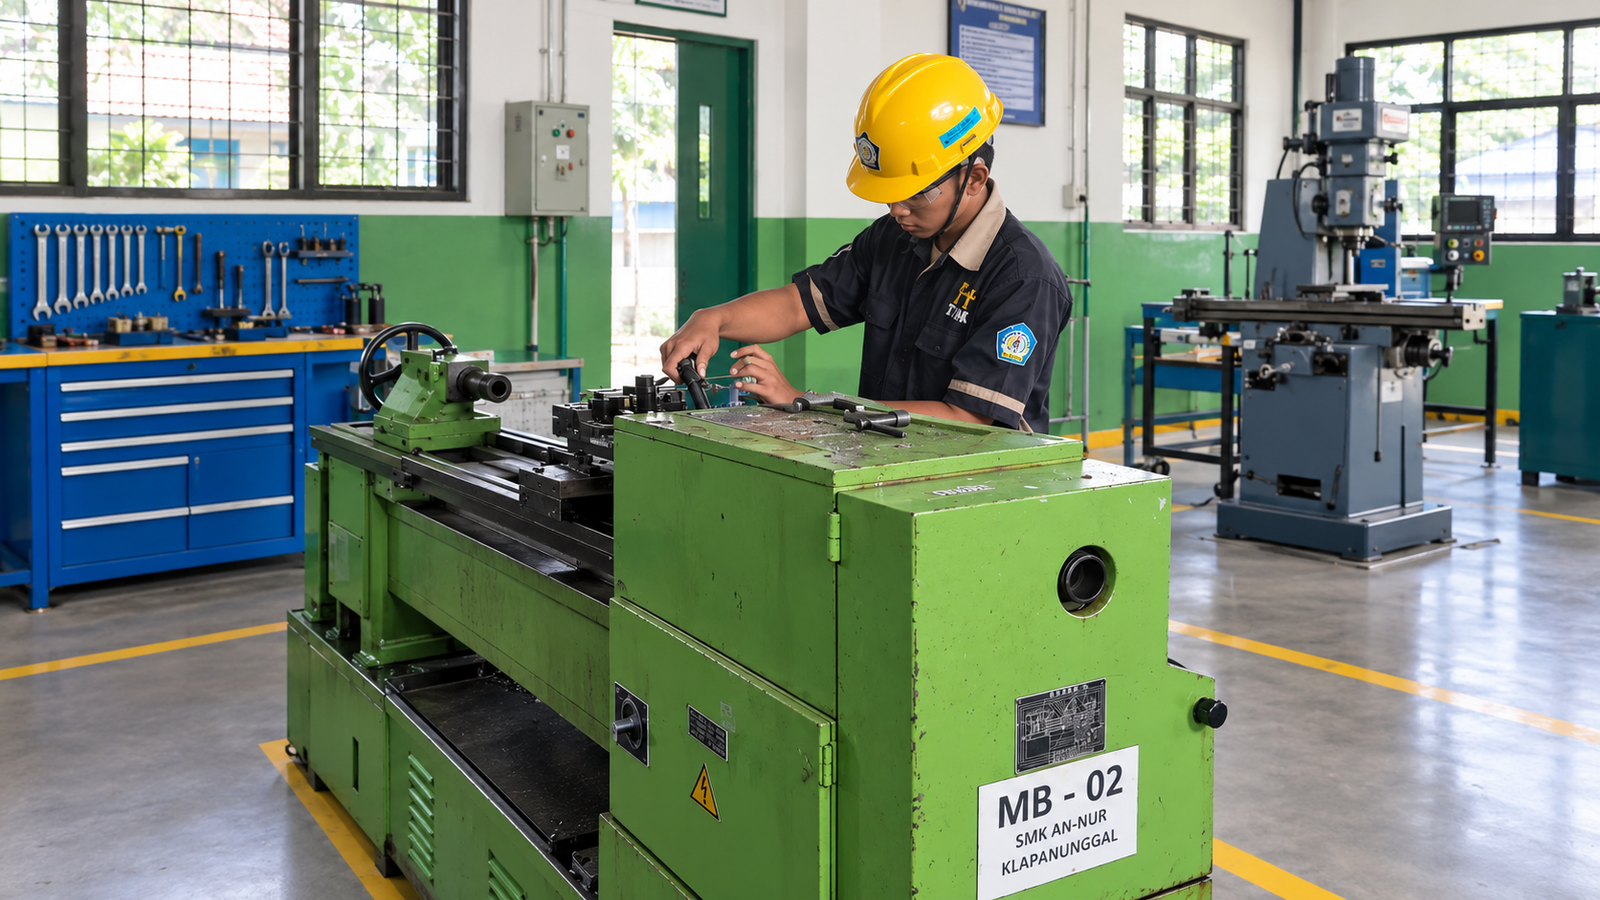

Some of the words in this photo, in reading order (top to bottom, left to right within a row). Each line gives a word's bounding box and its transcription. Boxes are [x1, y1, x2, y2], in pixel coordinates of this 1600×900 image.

[999, 785, 1052, 828] MB
[1064, 793, 1075, 801] -
[1087, 765, 1123, 801] 02
[1016, 827, 1048, 848] SMK
[1051, 809, 1107, 838] AN-NUR
[1001, 829, 1118, 876] KLAPANUNGGAL
